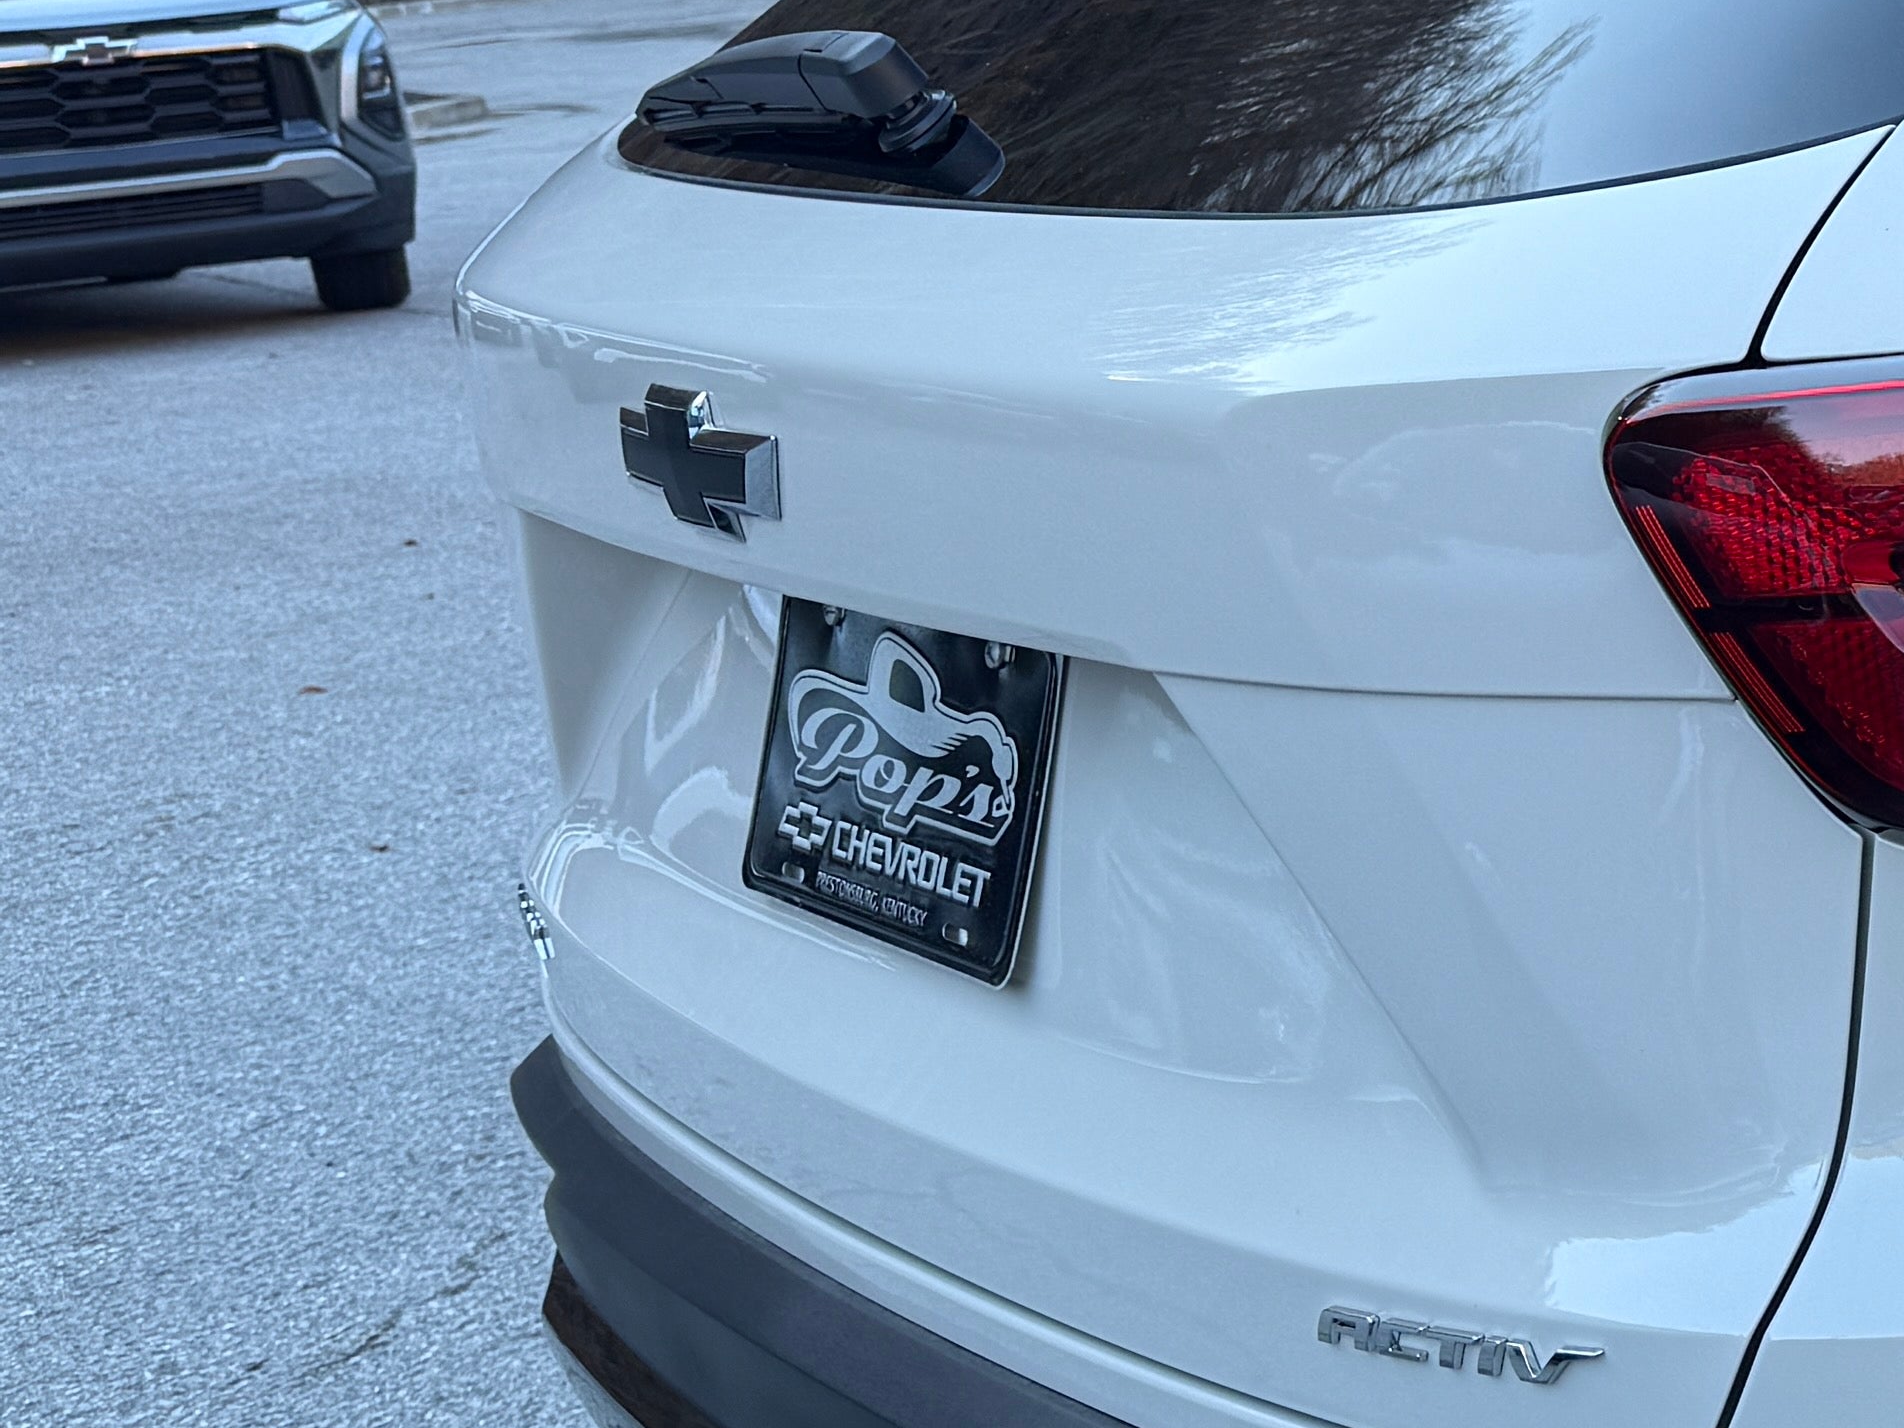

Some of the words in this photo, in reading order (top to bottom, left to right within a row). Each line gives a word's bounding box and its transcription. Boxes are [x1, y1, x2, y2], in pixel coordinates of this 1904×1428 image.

[801, 706, 995, 829] Pop's
[831, 820, 991, 909] CHEVROLET
[1317, 1304, 1606, 1385] ACTIV
